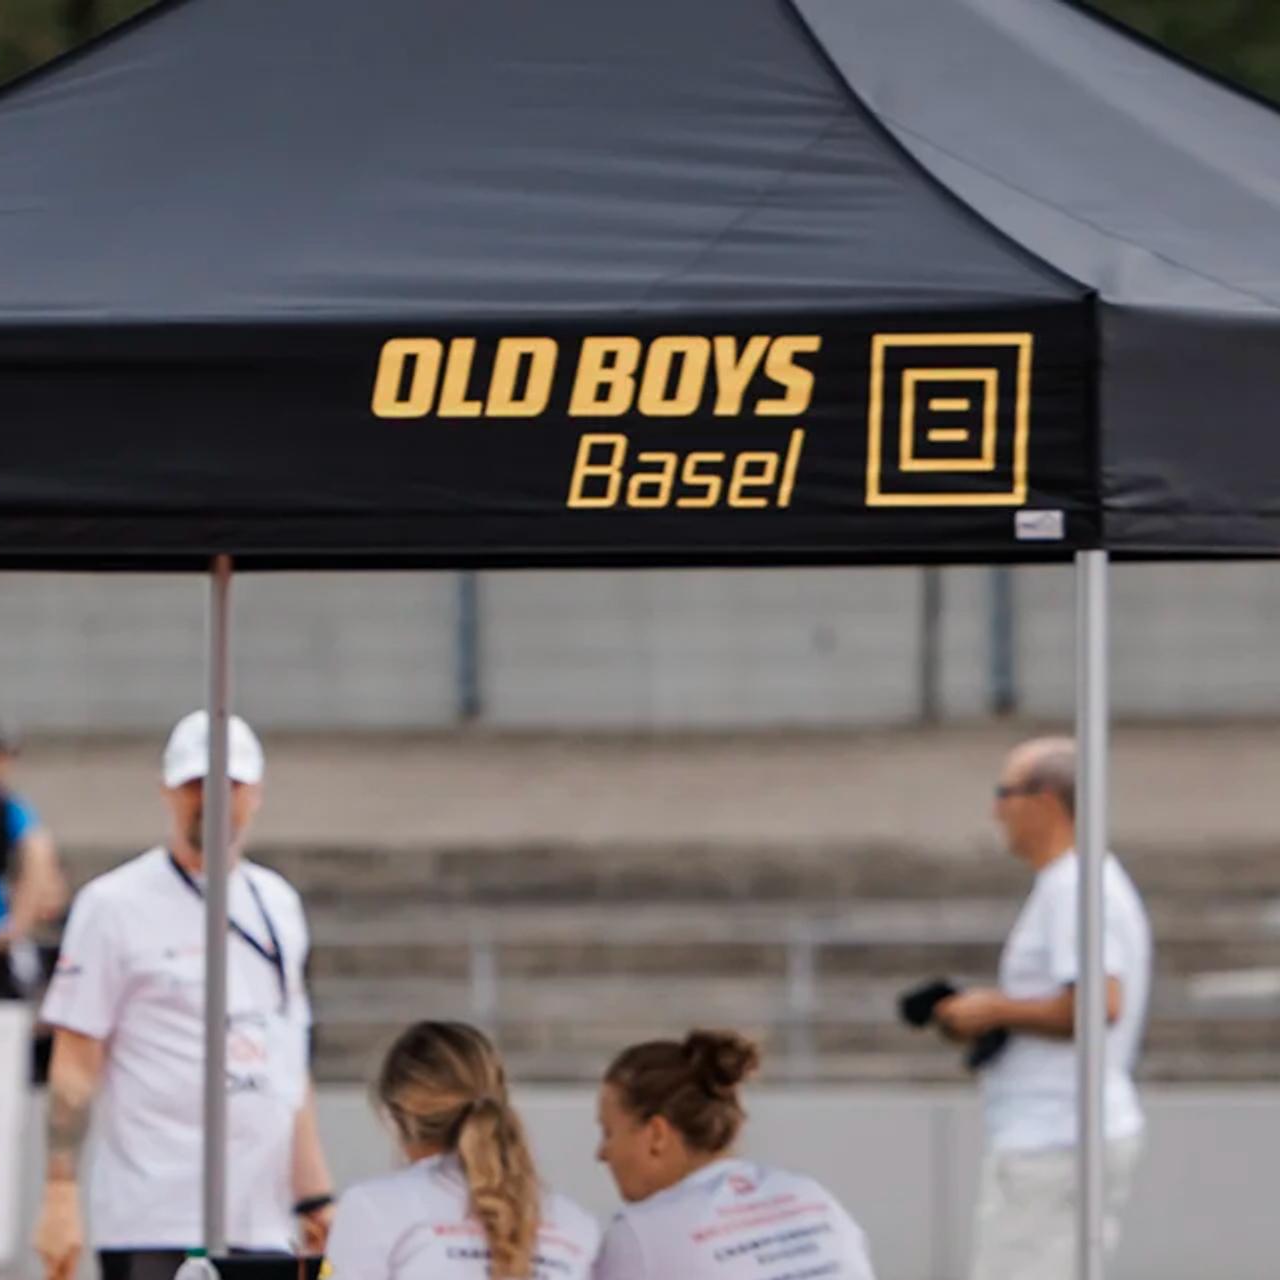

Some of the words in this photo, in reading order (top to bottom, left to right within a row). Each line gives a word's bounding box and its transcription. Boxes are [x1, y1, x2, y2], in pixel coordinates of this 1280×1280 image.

[371, 336, 559, 418] OLD
[568, 335, 821, 417] BOYS
[567, 428, 804, 508] Basel
